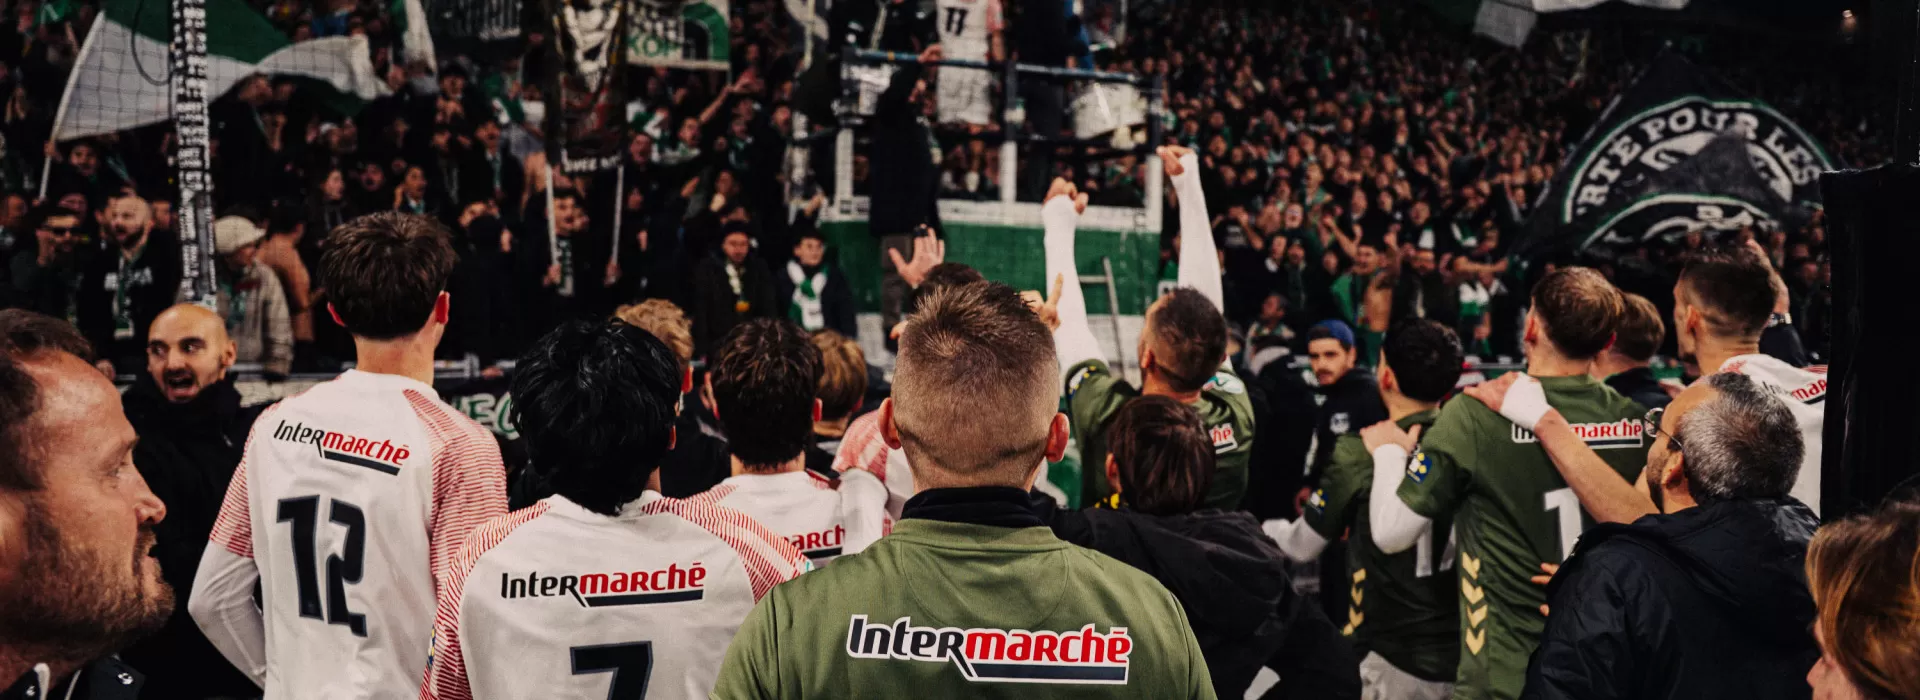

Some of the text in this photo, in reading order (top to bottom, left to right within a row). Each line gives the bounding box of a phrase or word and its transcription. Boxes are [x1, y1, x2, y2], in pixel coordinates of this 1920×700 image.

[944, 6, 969, 37] 11
[1577, 134, 1643, 216] RTE
[276, 494, 368, 638] 12
[569, 640, 654, 700] 7
